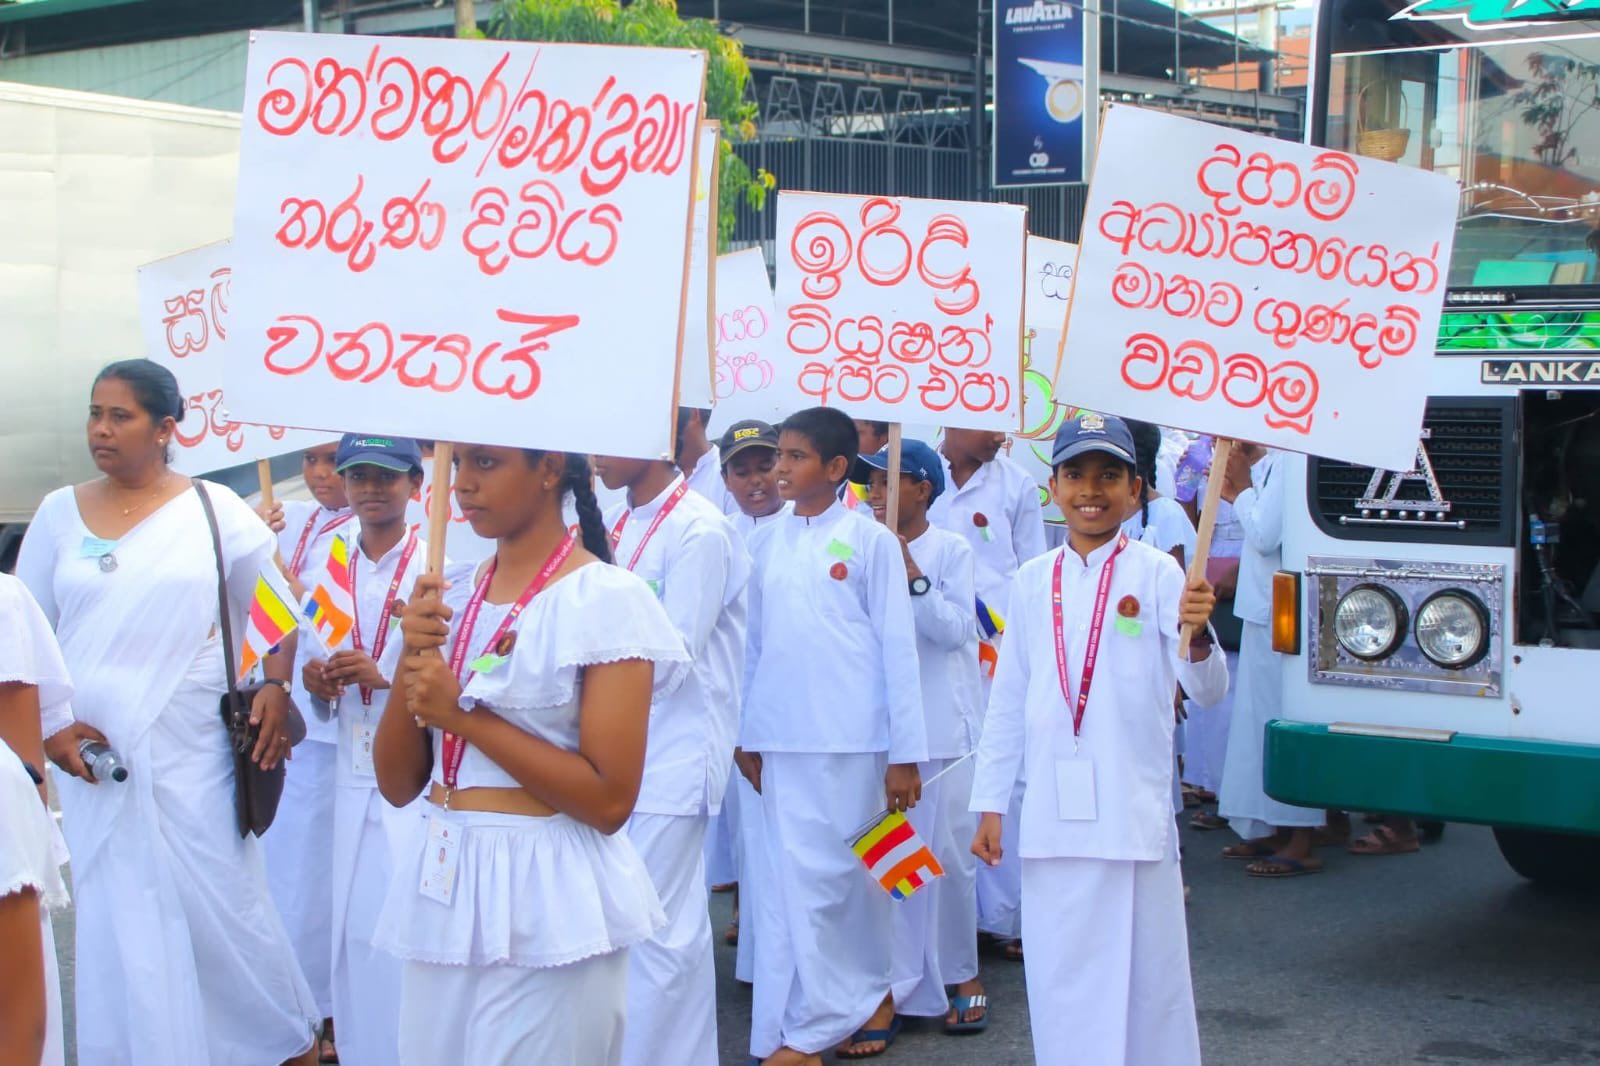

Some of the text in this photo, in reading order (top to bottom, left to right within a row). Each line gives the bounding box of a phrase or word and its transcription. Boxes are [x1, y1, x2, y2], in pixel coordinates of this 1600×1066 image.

[1005, 0, 1073, 24] LAVAZZA
[1196, 143, 1360, 222] දහම්
[274, 174, 624, 277] තරුණ දිවිය
[1110, 261, 1245, 329] මානව
[1253, 297, 1422, 370] ගුණදම්
[797, 361, 911, 406] අපට
[918, 363, 1011, 413] එපා
[1482, 361, 1600, 382] LANKA
